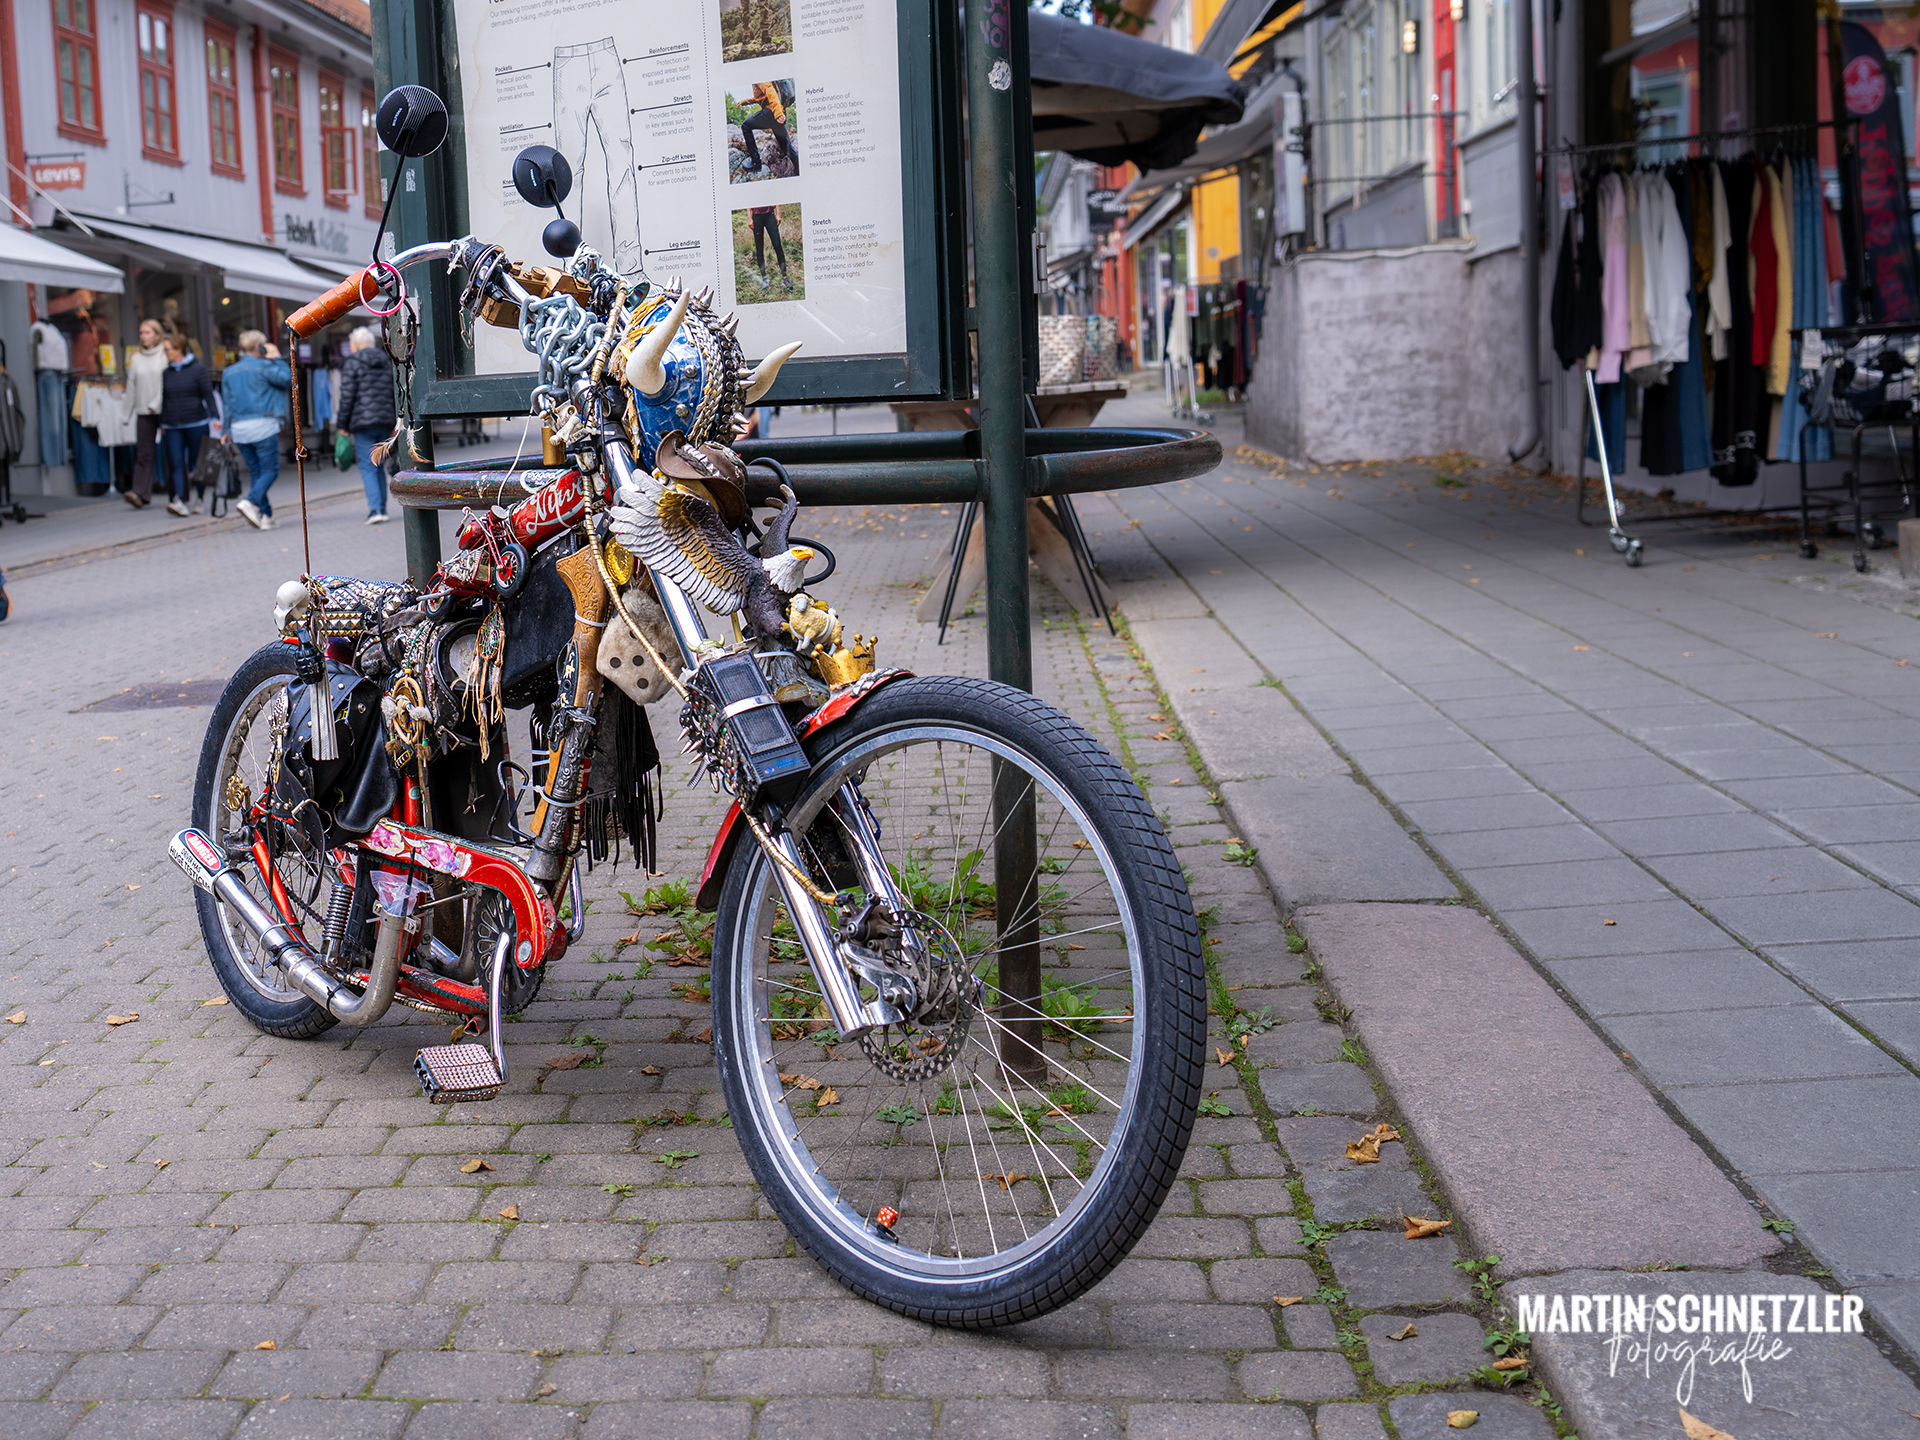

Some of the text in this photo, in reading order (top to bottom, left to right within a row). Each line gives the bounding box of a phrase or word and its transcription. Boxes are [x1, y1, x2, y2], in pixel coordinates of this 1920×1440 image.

[648, 43, 688, 54] Reinforcements
[806, 87, 824, 95] Hybrid
[673, 94, 692, 102] Stretch
[499, 123, 524, 131] Ventilation
[662, 154, 680, 162] Zip-off
[188, 836, 218, 866] DANGER
[170, 846, 184, 866] HUGE
[181, 848, 202, 872] DRIVER HAS
